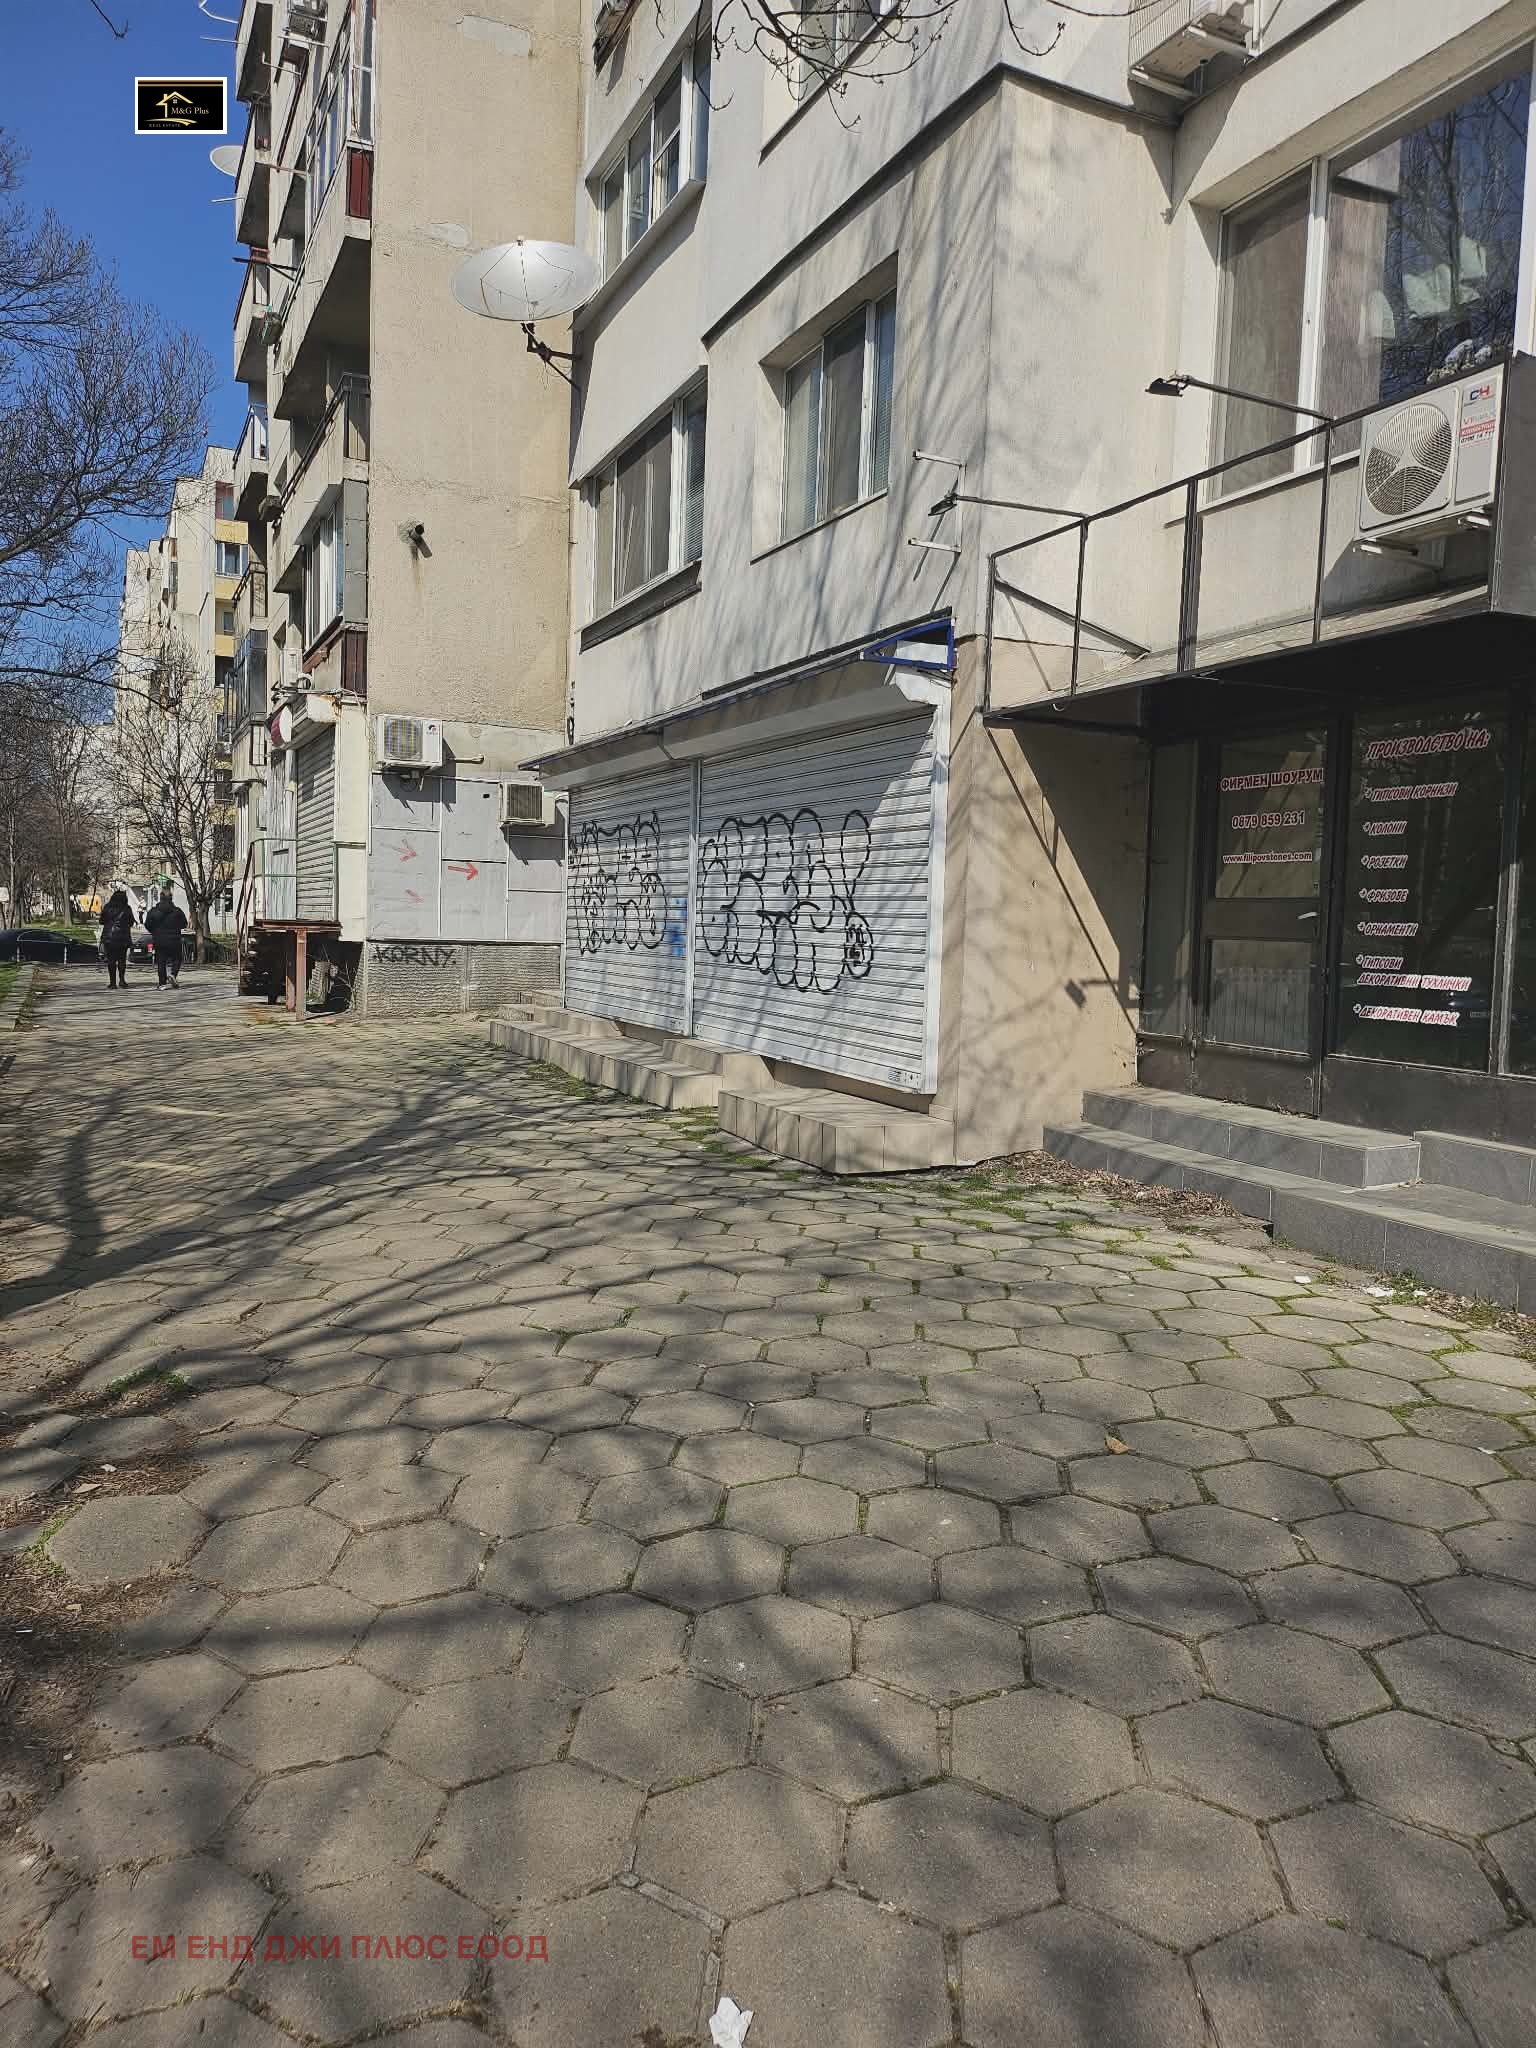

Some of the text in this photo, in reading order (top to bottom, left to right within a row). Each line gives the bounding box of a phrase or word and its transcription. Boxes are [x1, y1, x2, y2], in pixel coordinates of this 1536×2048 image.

[1366, 729, 1464, 760] ПРОИЗВОДСТВО
[1221, 768, 1324, 791] ФИРМЕН ШОУРУМ
[1370, 782, 1459, 801] ГИПСОВИ КОРНИЗИ
[1231, 810, 1305, 829] 0879 859 231
[1368, 820, 1408, 836] КОЛОНИ
[1222, 851, 1313, 864] www.filipovstones.com
[1367, 854, 1409, 869] РОЗЕТКИ
[1366, 888, 1409, 903] ФРИЗОВЕ
[1364, 922, 1419, 937] ОРНАМЕНТИ
[1361, 955, 1404, 970] ГИПСОВИ
[1357, 972, 1472, 992] ДЕКОРАТИВНИ ТУХЛИЧКИ
[1359, 1005, 1460, 1027] ДЕКОРАТИВЕН КАМЪК
